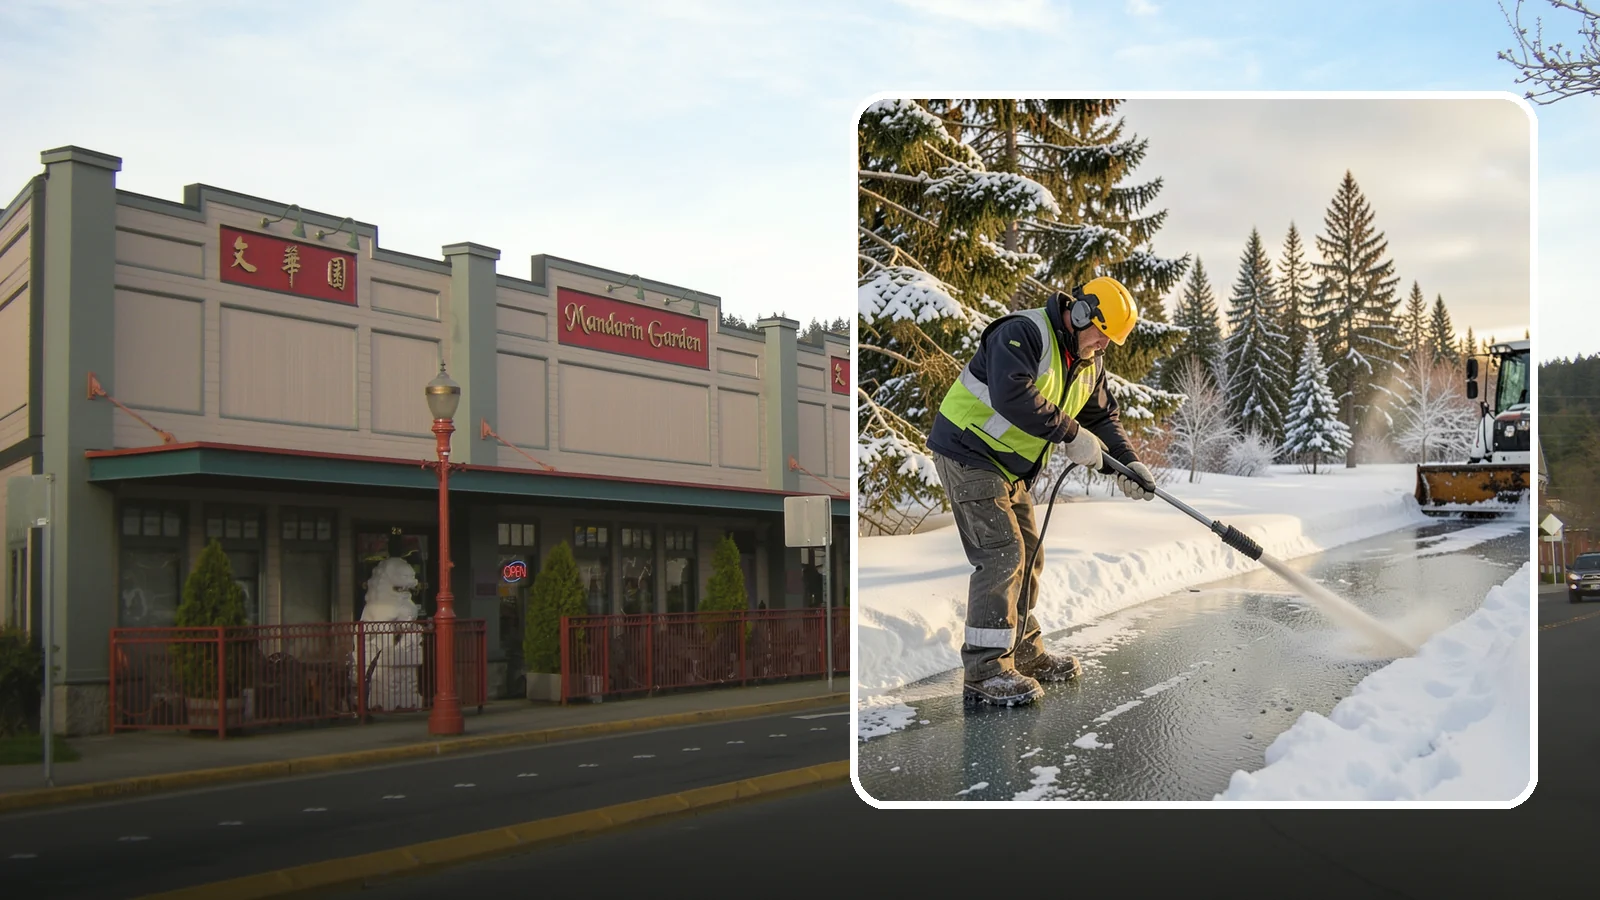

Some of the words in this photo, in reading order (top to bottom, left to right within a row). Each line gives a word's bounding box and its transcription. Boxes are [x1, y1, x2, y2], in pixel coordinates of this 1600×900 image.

[231, 235, 346, 290] 文華園
[564, 302, 644, 340] Mandarin
[648, 320, 701, 351] Garden
[503, 565, 527, 578] OPEN
